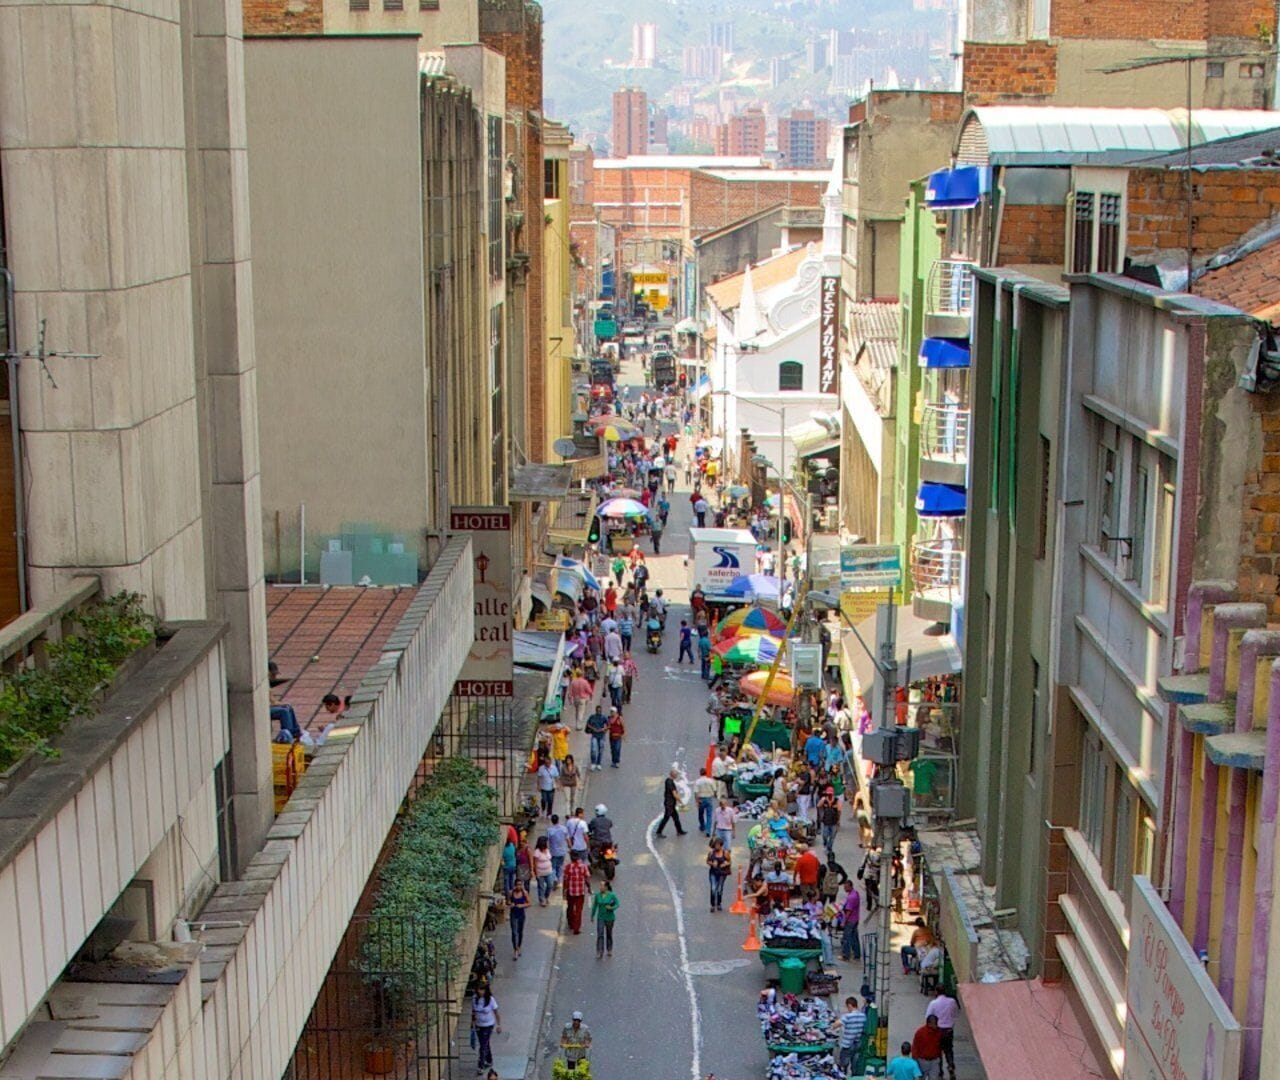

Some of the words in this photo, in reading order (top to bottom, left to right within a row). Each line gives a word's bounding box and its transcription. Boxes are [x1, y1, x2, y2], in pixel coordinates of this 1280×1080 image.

[822, 278, 836, 392] RESTAURANT
[454, 516, 508, 529] HOTEL
[474, 598, 508, 616] alle
[474, 624, 509, 642] eal
[458, 683, 509, 695] HOTEL
